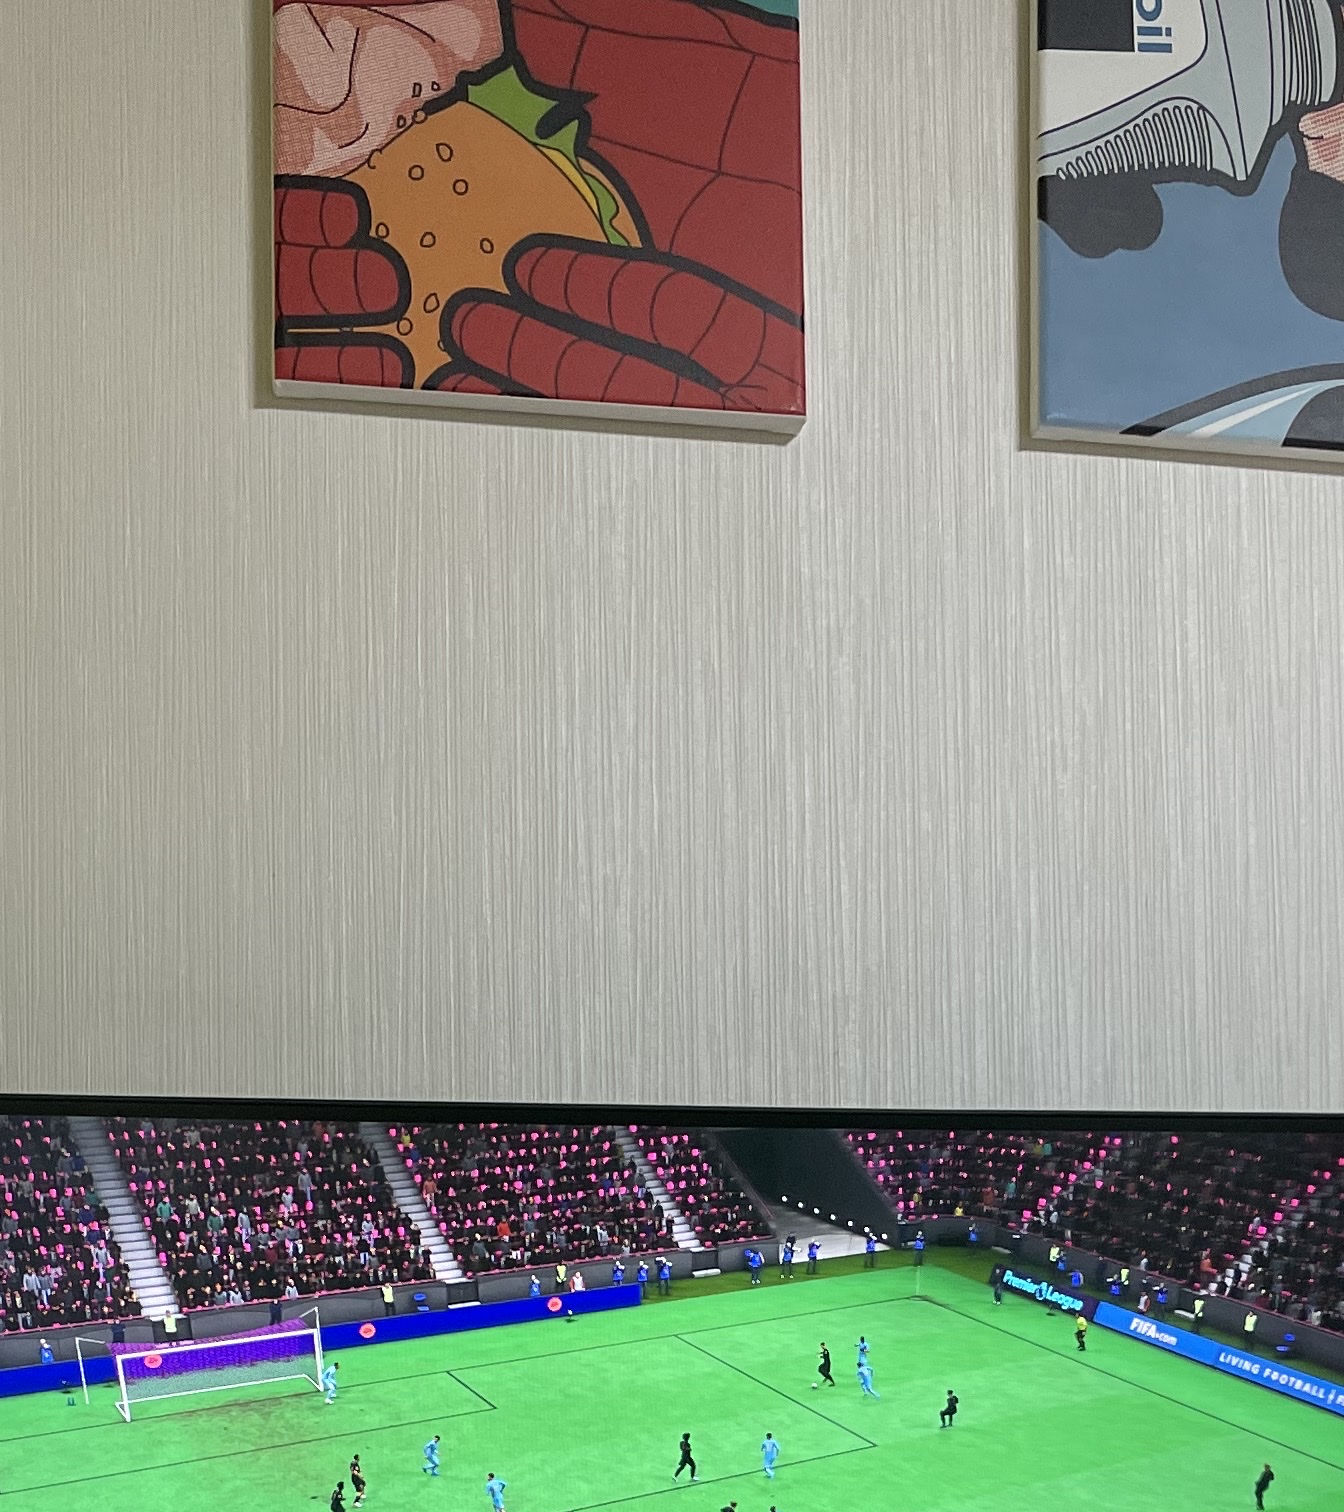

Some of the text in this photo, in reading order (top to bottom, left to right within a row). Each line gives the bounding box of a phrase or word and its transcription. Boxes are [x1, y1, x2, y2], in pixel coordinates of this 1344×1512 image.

[1003, 1269, 1083, 1311] Premier League
[1218, 1352, 1261, 1375] LIVING
[1262, 1367, 1326, 1400] FOOTBALL
